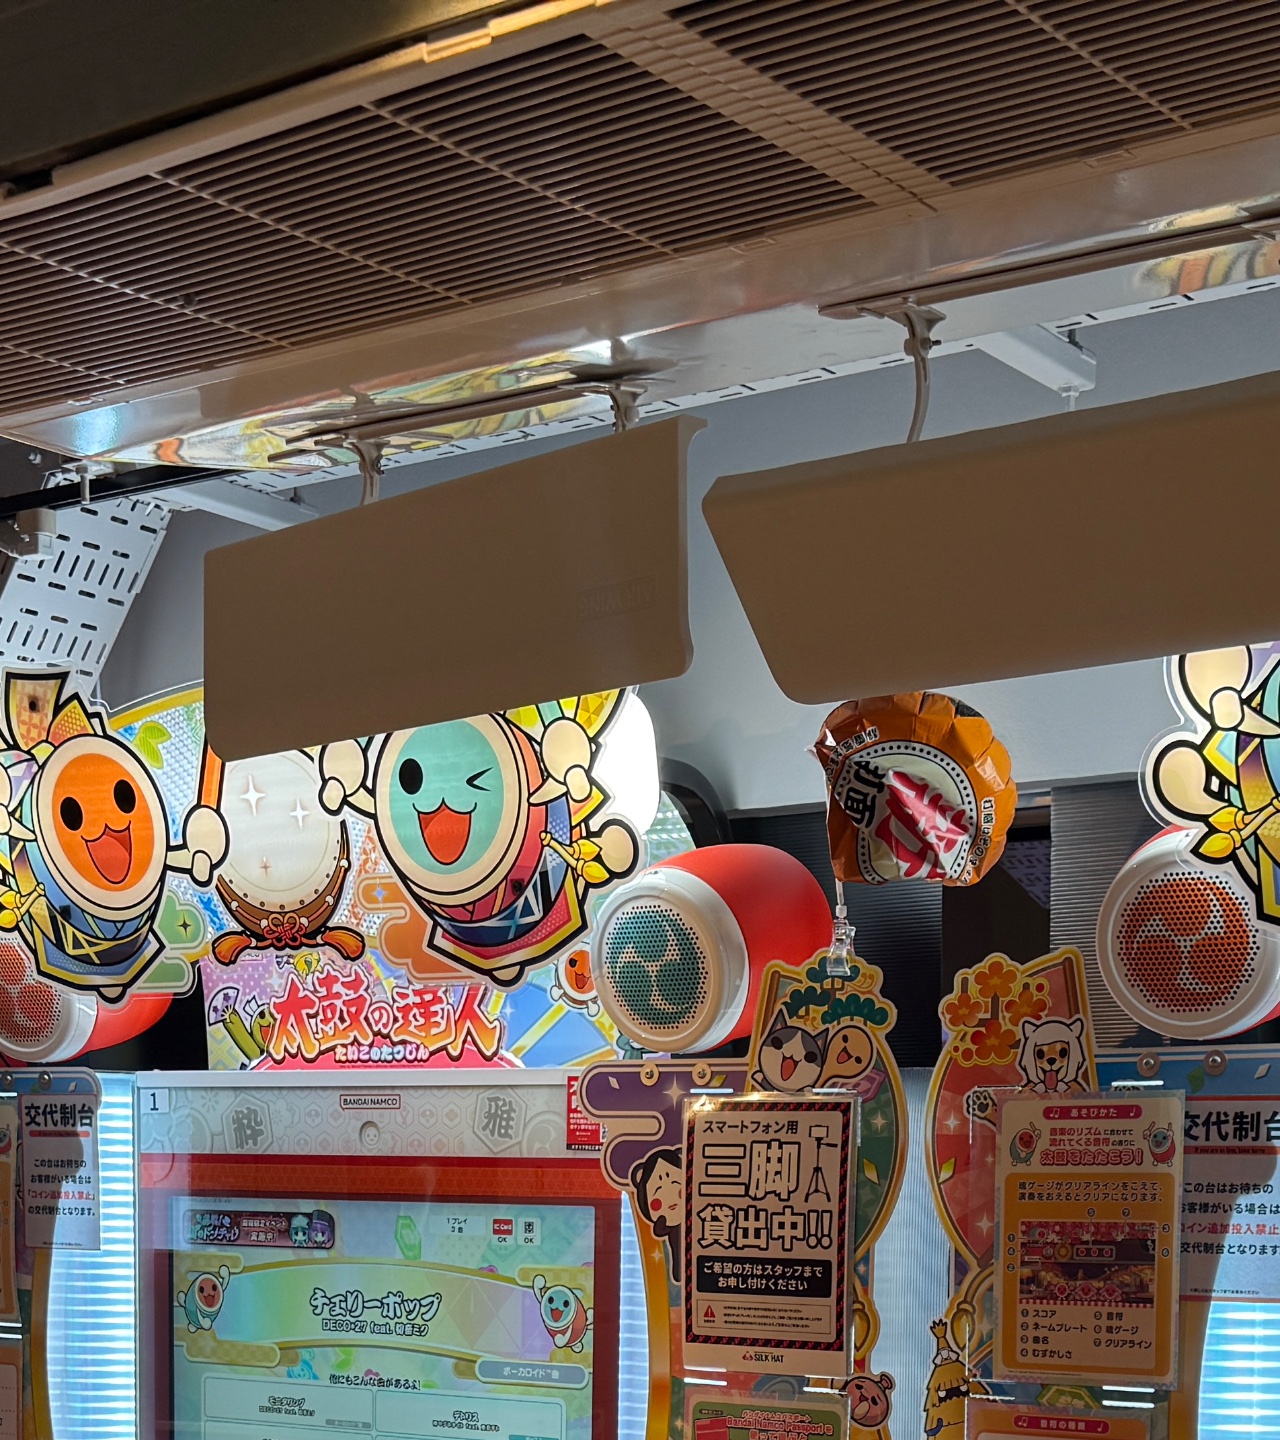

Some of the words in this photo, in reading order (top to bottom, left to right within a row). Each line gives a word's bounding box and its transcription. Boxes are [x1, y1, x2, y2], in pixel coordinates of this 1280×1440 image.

[269, 964, 500, 1062] 太鼓の達人
[334, 1044, 430, 1062] たいこのたつじん
[150, 1093, 159, 1111] 1
[343, 1097, 369, 1106] BANDAI
[371, 1097, 398, 1106] NAMCO
[25, 1103, 94, 1127] 交代制台
[1070, 1108, 1118, 1117] あそびかた
[703, 1120, 799, 1135] スマートフォン用
[34, 1159, 86, 1168] この台はお待ちの
[1040, 1148, 1143, 1166] 太鼓をたたこう!
[698, 1139, 801, 1201] 三脚
[30, 1175, 91, 1185] お客様がいる場合は
[1184, 1182, 1273, 1195] この台はお待ちの
[28, 1206, 95, 1217] の交代制台となります。
[697, 1203, 832, 1251] 貸出中!!
[704, 1261, 823, 1278] ご希望の方はスタッフまで
[718, 1276, 807, 1290] お申し付けください
[310, 1287, 442, 1322] チェリーポップ
[1032, 1322, 1087, 1332] ネームプレート
[1105, 1339, 1151, 1349] クリアライン
[754, 1353, 770, 1363] SILK
[771, 1354, 784, 1364] HAT
[329, 1373, 421, 1391] 他にもこんな曲があるよ!
[727, 1416, 755, 1428] Bandai
[756, 1419, 784, 1430] Namco
[786, 1420, 822, 1434] Passport
